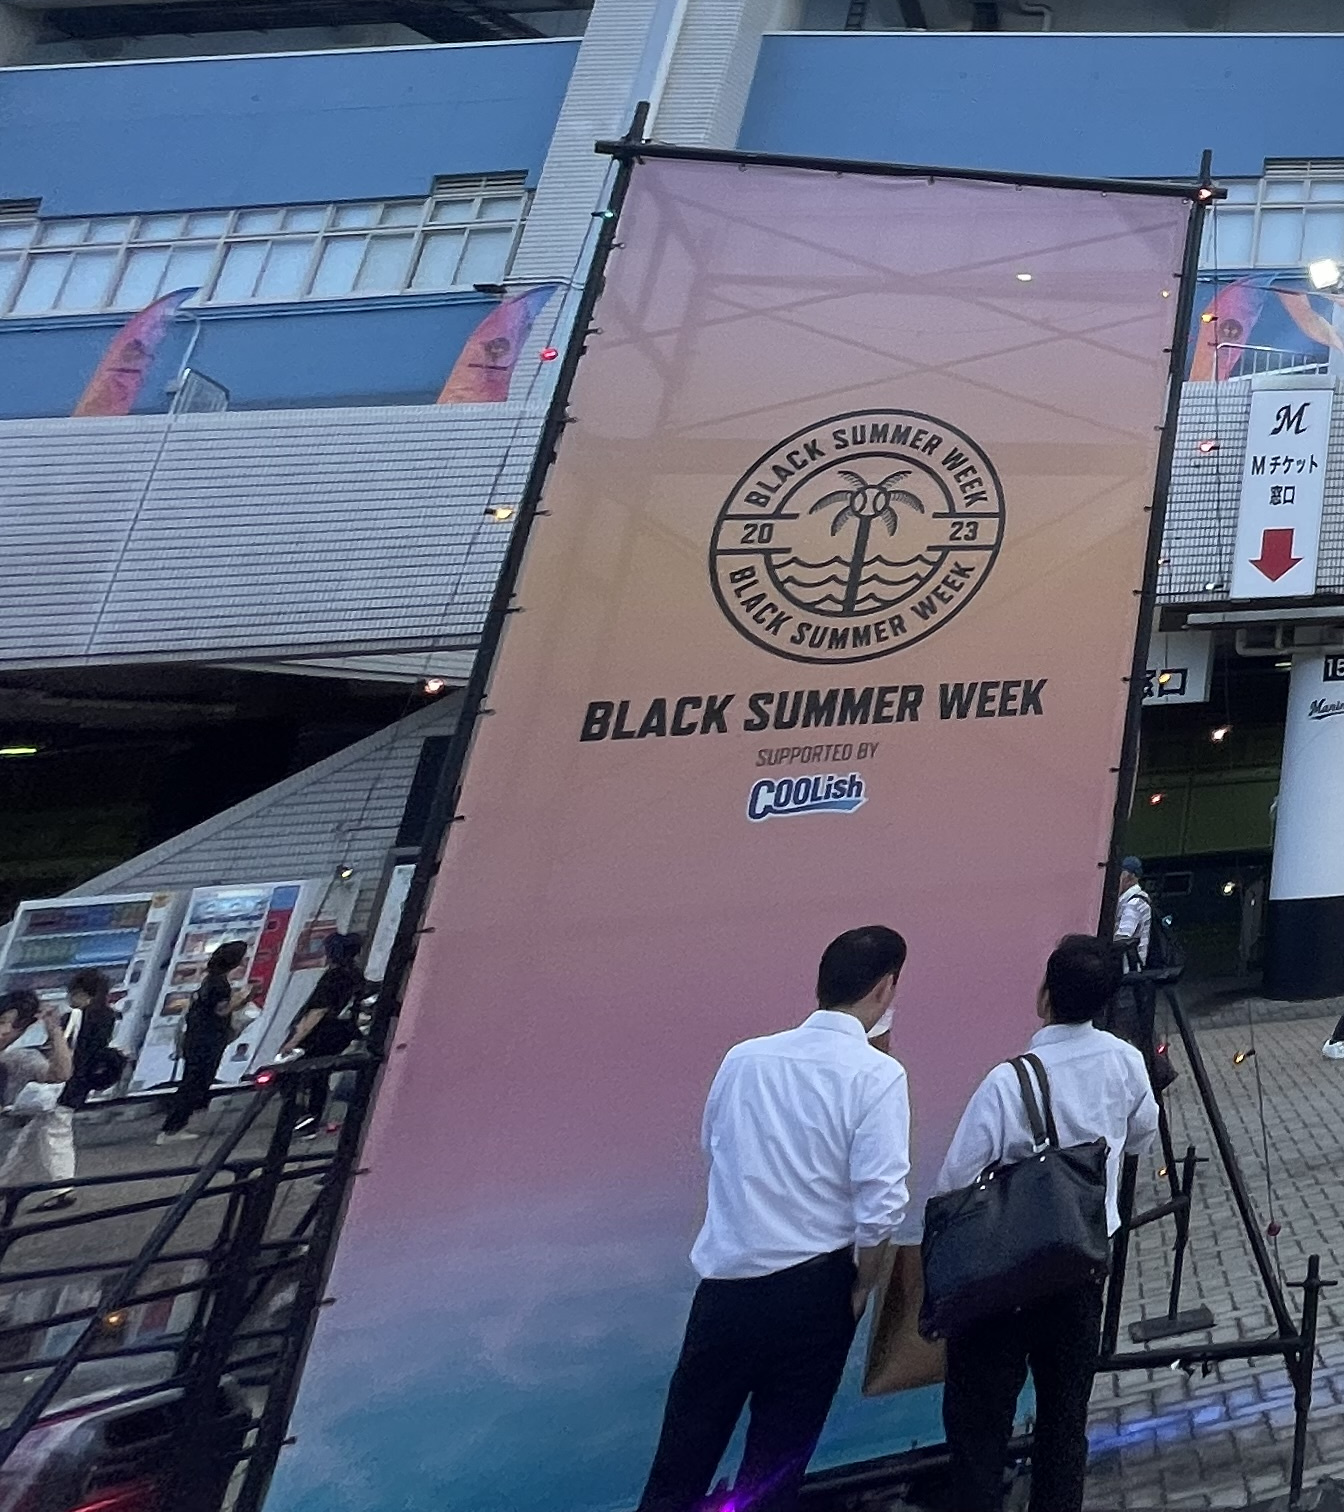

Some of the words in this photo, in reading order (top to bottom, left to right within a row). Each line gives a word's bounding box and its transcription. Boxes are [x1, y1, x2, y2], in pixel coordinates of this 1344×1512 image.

[744, 438, 826, 510] BLACK
[832, 422, 943, 456] SUMMER
[940, 446, 989, 509] WEEK
[1269, 484, 1296, 506] 窓口
[741, 523, 774, 545] 20
[948, 520, 980, 542] 23
[729, 565, 793, 637] BLACK
[790, 614, 907, 651] SUMMER
[911, 560, 976, 622] WEEK
[579, 693, 736, 742] BLACK
[743, 682, 925, 732] SUMMER
[938, 678, 1048, 719] WEEK
[756, 743, 853, 768] SUPPORTED
[856, 741, 881, 761] BY
